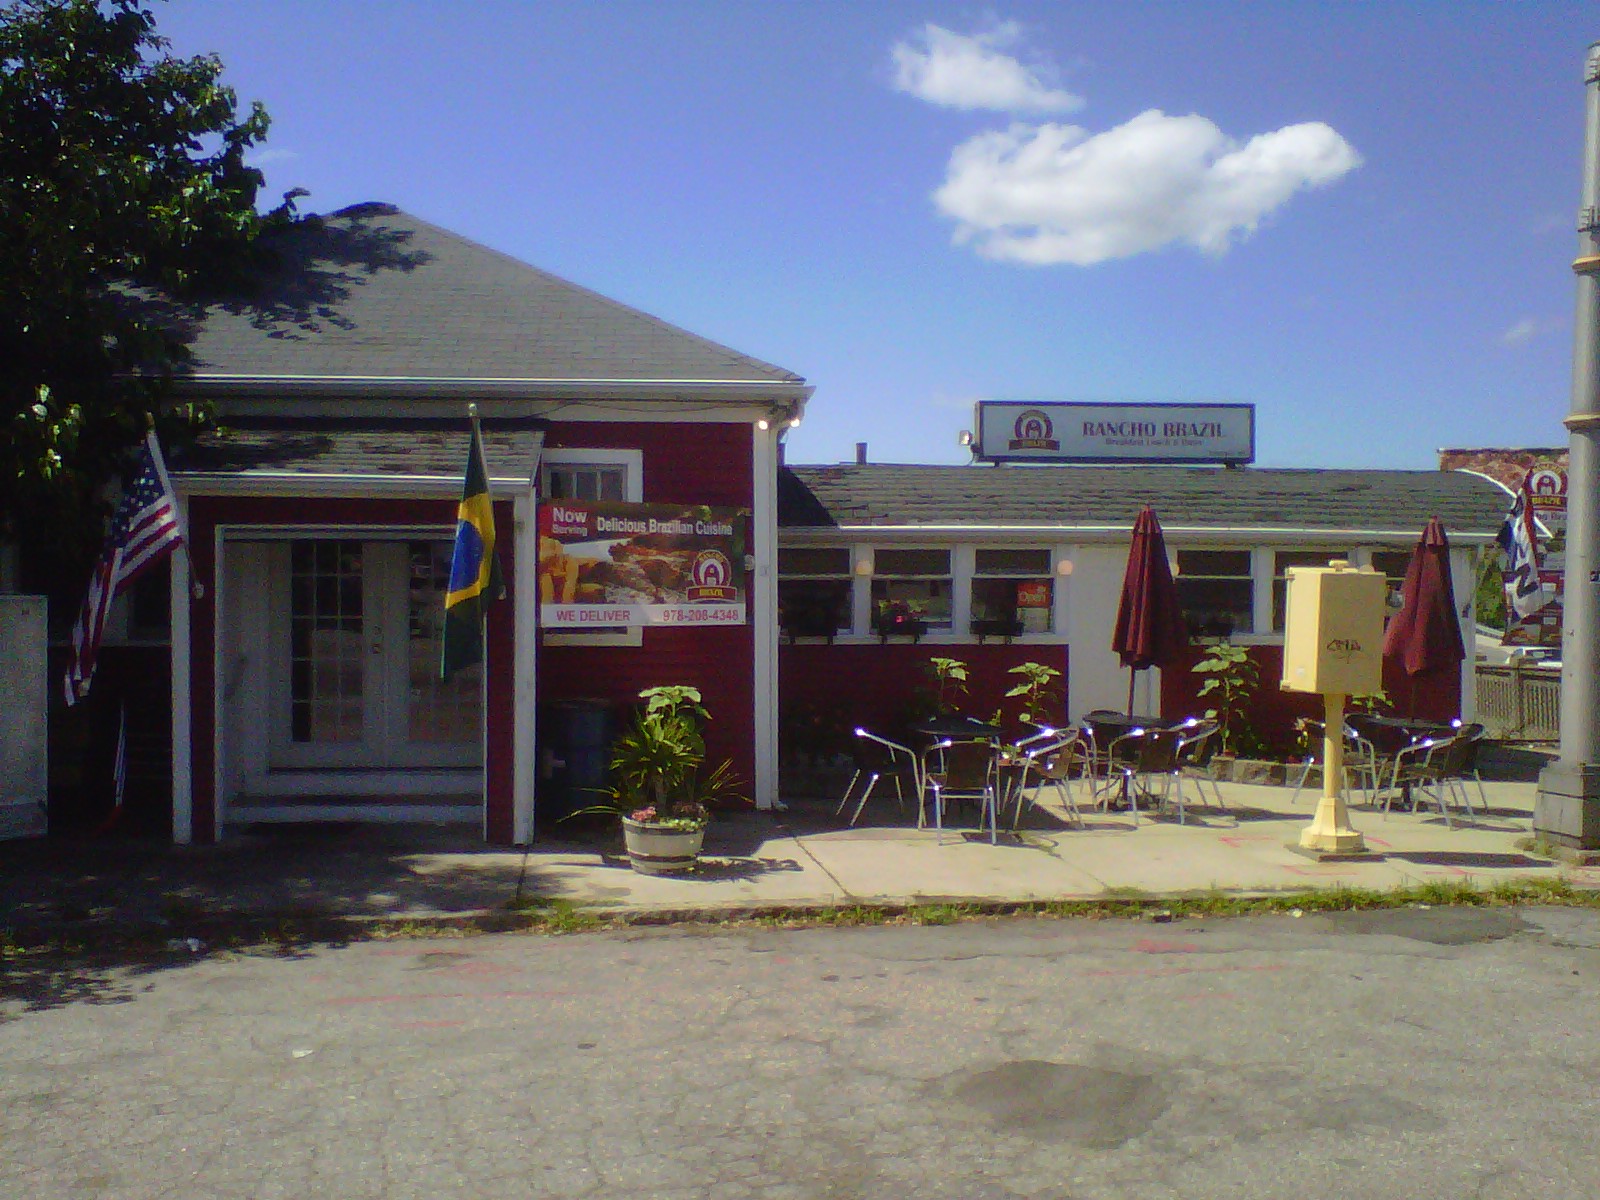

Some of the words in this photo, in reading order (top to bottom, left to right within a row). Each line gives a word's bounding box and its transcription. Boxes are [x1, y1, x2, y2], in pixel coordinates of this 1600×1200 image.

[1083, 421, 1157, 437] RANCHO
[1163, 421, 1223, 438] BRAZIL
[553, 507, 588, 523] Now
[553, 524, 588, 537] Serving
[597, 516, 646, 534] Delicious
[649, 519, 694, 535] Brazilian
[696, 521, 733, 536] Cuisine
[556, 610, 576, 621] WE
[579, 611, 631, 622] DELIVER
